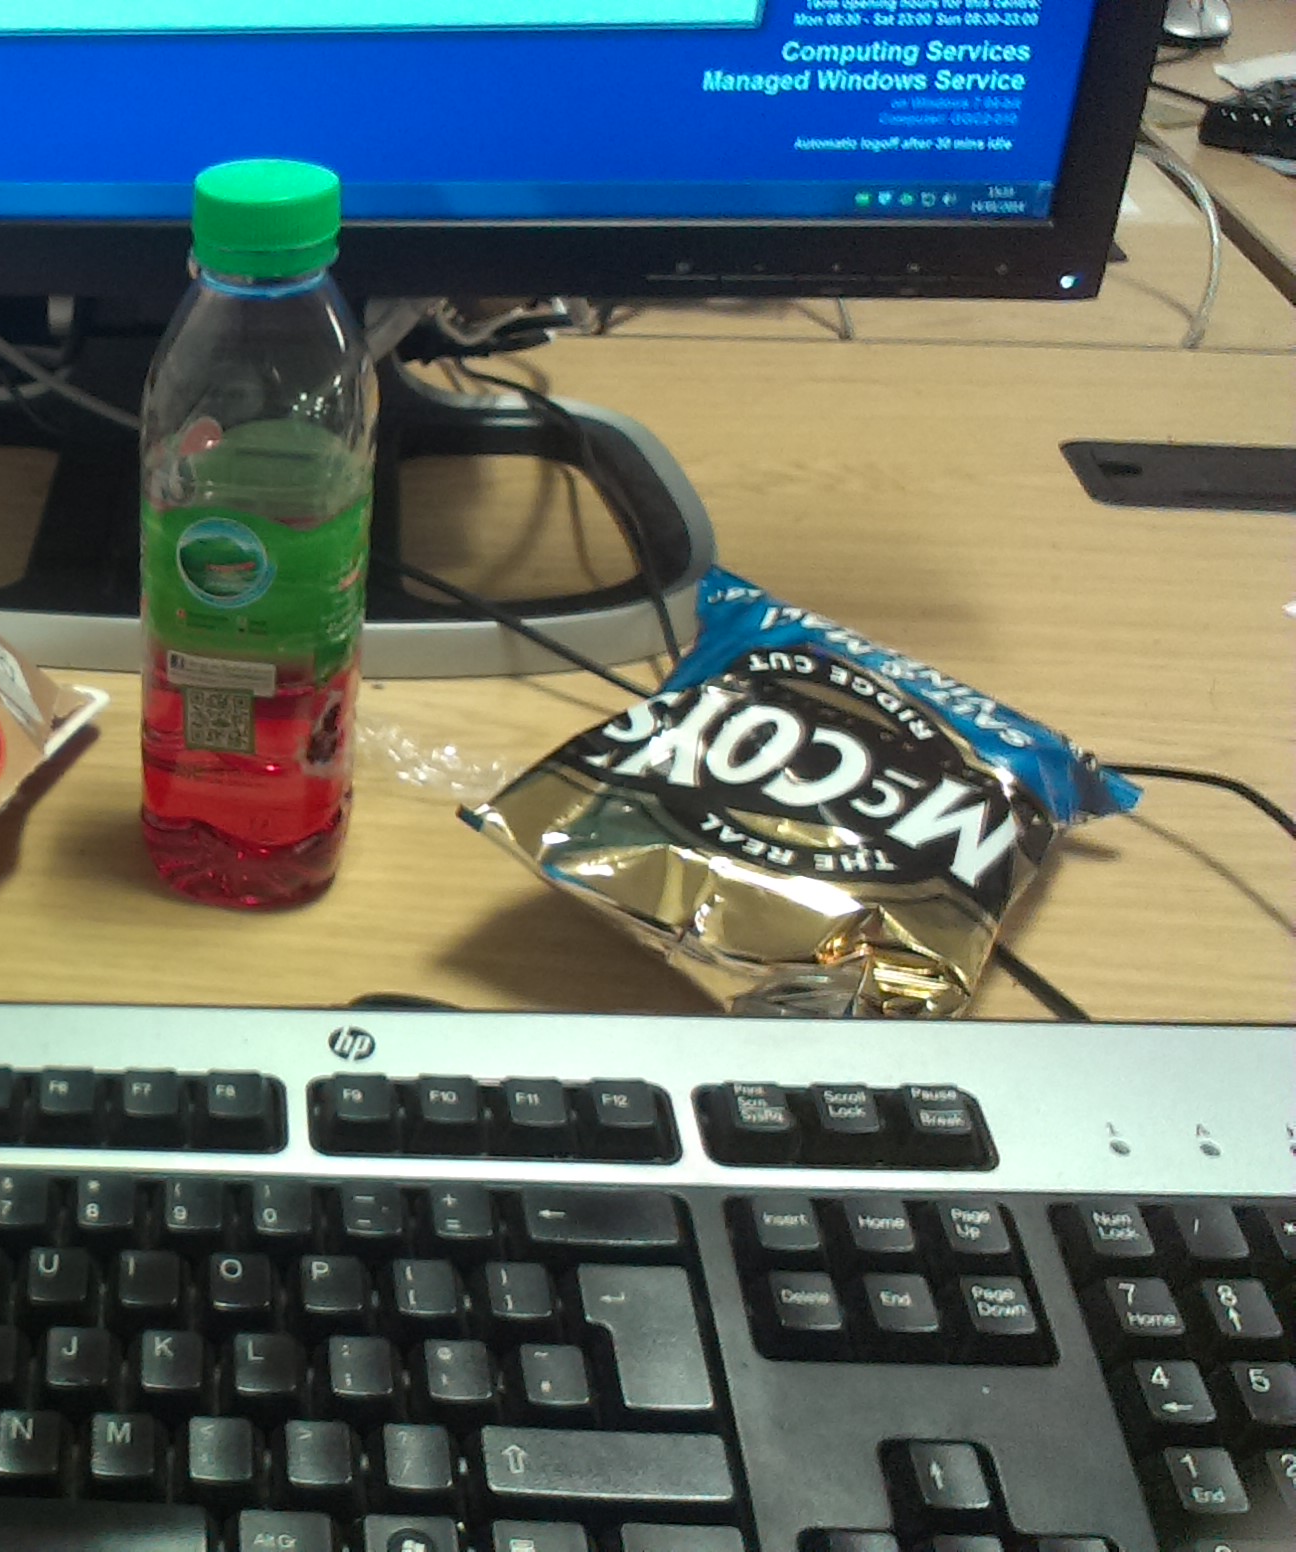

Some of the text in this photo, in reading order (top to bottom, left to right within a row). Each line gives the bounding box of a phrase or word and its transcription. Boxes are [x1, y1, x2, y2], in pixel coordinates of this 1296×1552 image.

[793, 12, 824, 26] Mon
[872, 12, 895, 26] Sat
[935, 12, 963, 26] Sun
[781, 40, 1031, 67] Computing Services
[703, 69, 1026, 95] Managed Windows Service
[794, 136, 858, 150] Automatic
[860, 136, 900, 152] logoff
[901, 136, 933, 150] after
[749, 651, 817, 674] CUT
[830, 665, 936, 740] RIDGE
[700, 812, 899, 873] THE REAL
[333, 1026, 372, 1061] hp
[49, 1080, 69, 1094] F6
[131, 1082, 152, 1097] F7
[215, 1084, 236, 1097] F8
[342, 1088, 363, 1102] F9
[910, 1087, 957, 1101] Pause
[429, 1091, 457, 1103] F10
[515, 1092, 540, 1105] F11
[602, 1093, 629, 1108] F12
[824, 1090, 865, 1103] Scroll
[828, 1105, 865, 1118] Lock
[920, 1112, 965, 1127] Break
[2, 1200, 13, 1215] 7
[85, 1203, 100, 1219] 8
[173, 1206, 188, 1220] 9
[263, 1208, 277, 1223] 0
[763, 1211, 807, 1226] Insert
[858, 1215, 904, 1230] Home
[950, 1208, 992, 1225] Page
[955, 1225, 980, 1241] Up
[37, 1254, 60, 1274] U
[127, 1257, 135, 1275] I
[220, 1258, 243, 1279] O
[311, 1261, 329, 1279] P
[780, 1289, 830, 1305] Delete
[880, 1291, 911, 1307] End
[971, 1285, 1015, 1302] Page
[1118, 1282, 1135, 1306] 7
[1217, 1284, 1238, 1307] 8
[977, 1302, 1026, 1317] Down
[1127, 1311, 1177, 1326] Home
[61, 1336, 78, 1356] J
[155, 1337, 173, 1357] K
[248, 1341, 265, 1361] L
[1151, 1365, 1170, 1390] 4
[1249, 1368, 1271, 1393] 5
[10, 1418, 33, 1440] N
[107, 1421, 130, 1443] M
[1180, 1453, 1198, 1478] 1
[278, 1534, 296, 1548] Gr
